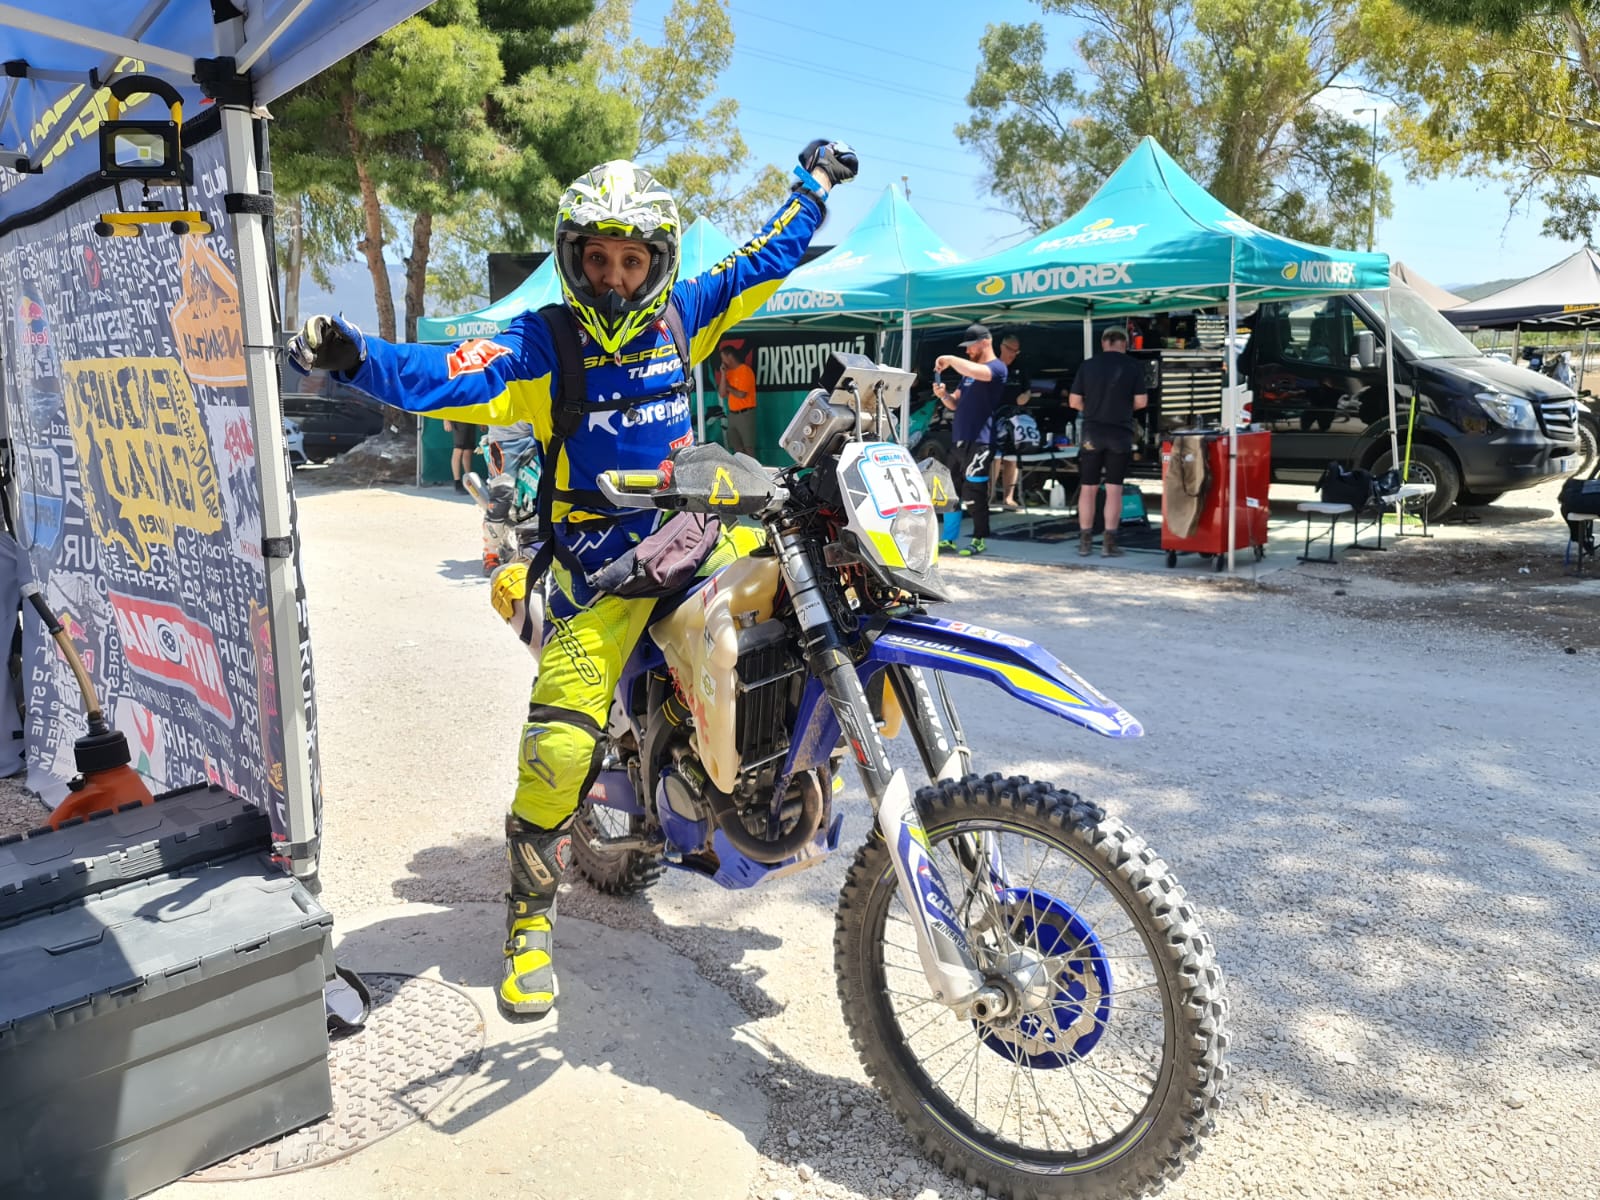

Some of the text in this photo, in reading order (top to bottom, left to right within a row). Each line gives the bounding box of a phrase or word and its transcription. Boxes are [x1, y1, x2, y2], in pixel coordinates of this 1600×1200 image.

[1011, 263, 1132, 295] MOTOREX
[1300, 261, 1357, 284] MOTOREX
[766, 291, 845, 312] MOTOREX
[584, 343, 679, 369] SHERC
[628, 357, 684, 380] TURKI
[756, 336, 866, 386] AKRAPO
[1015, 424, 1040, 442] 36
[884, 467, 921, 504] 15
[932, 920, 969, 953] MINERVA
